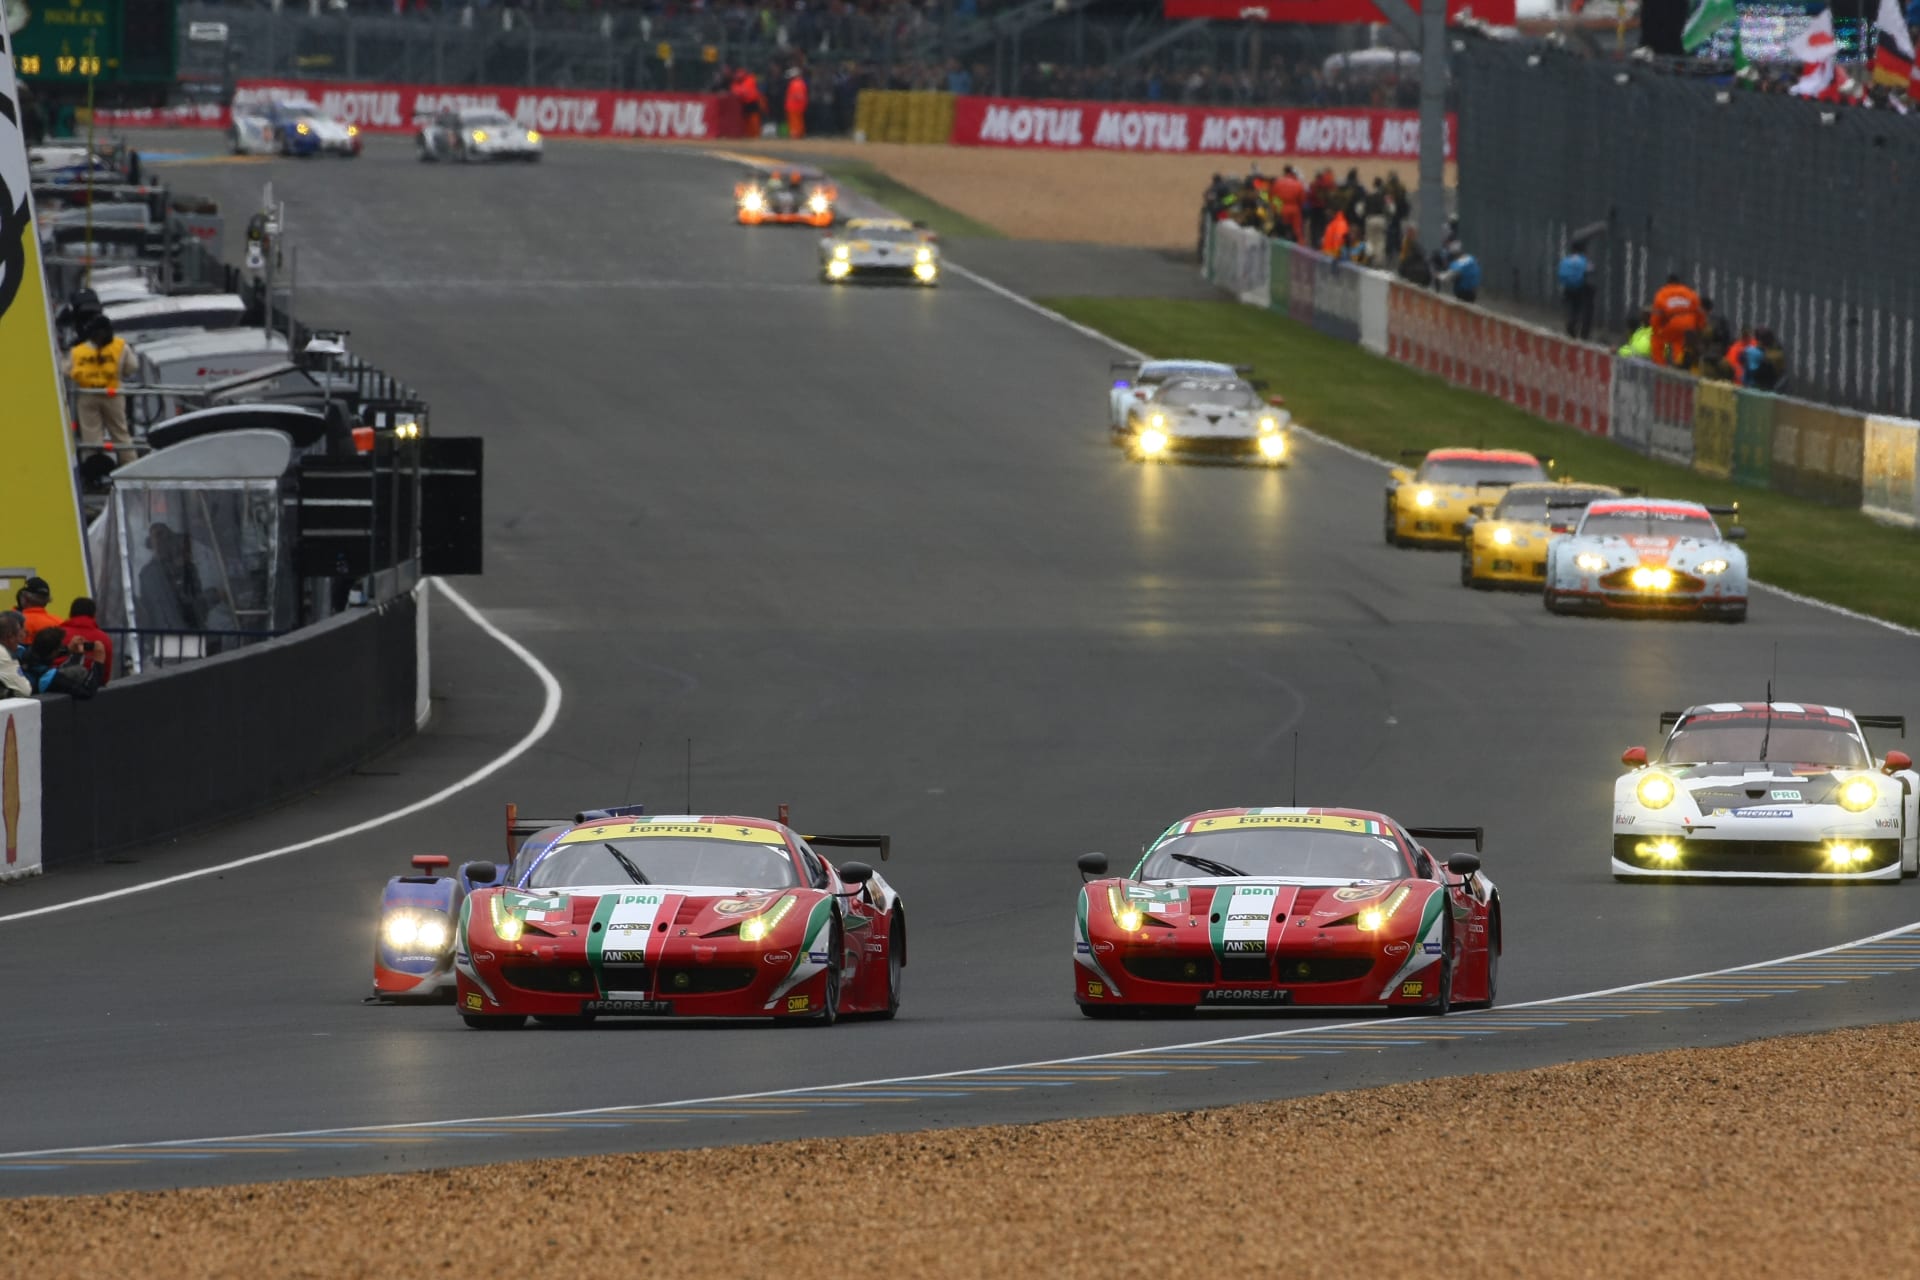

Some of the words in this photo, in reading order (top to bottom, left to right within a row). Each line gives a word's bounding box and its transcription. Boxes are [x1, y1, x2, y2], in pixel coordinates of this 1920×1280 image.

[320, 91, 402, 126] MOTUL
[515, 95, 601, 131] MOTUL
[612, 97, 708, 135] MOTUL
[979, 104, 1083, 144] MOTUL
[1092, 109, 1189, 150] MOTUL
[1199, 115, 1286, 151] MOTUL
[1295, 115, 1373, 151] MOTUL
[1378, 117, 1451, 156] MOL
[1686, 711, 1850, 729] PORSCHE
[1773, 790, 1800, 799] PRO
[1736, 809, 1792, 817] MICHELIN
[1238, 816, 1321, 824] Ferrari
[626, 825, 713, 834] Ferrari
[1128, 886, 1180, 900] 51
[1226, 941, 1264, 951] ANSYS
[604, 951, 642, 961] ANSYS
[1402, 983, 1423, 994] OMP
[1205, 989, 1288, 999] AFCORSE.IT
[586, 1000, 669, 1010] AFCORSE.IT
[787, 997, 809, 1010] OMP
